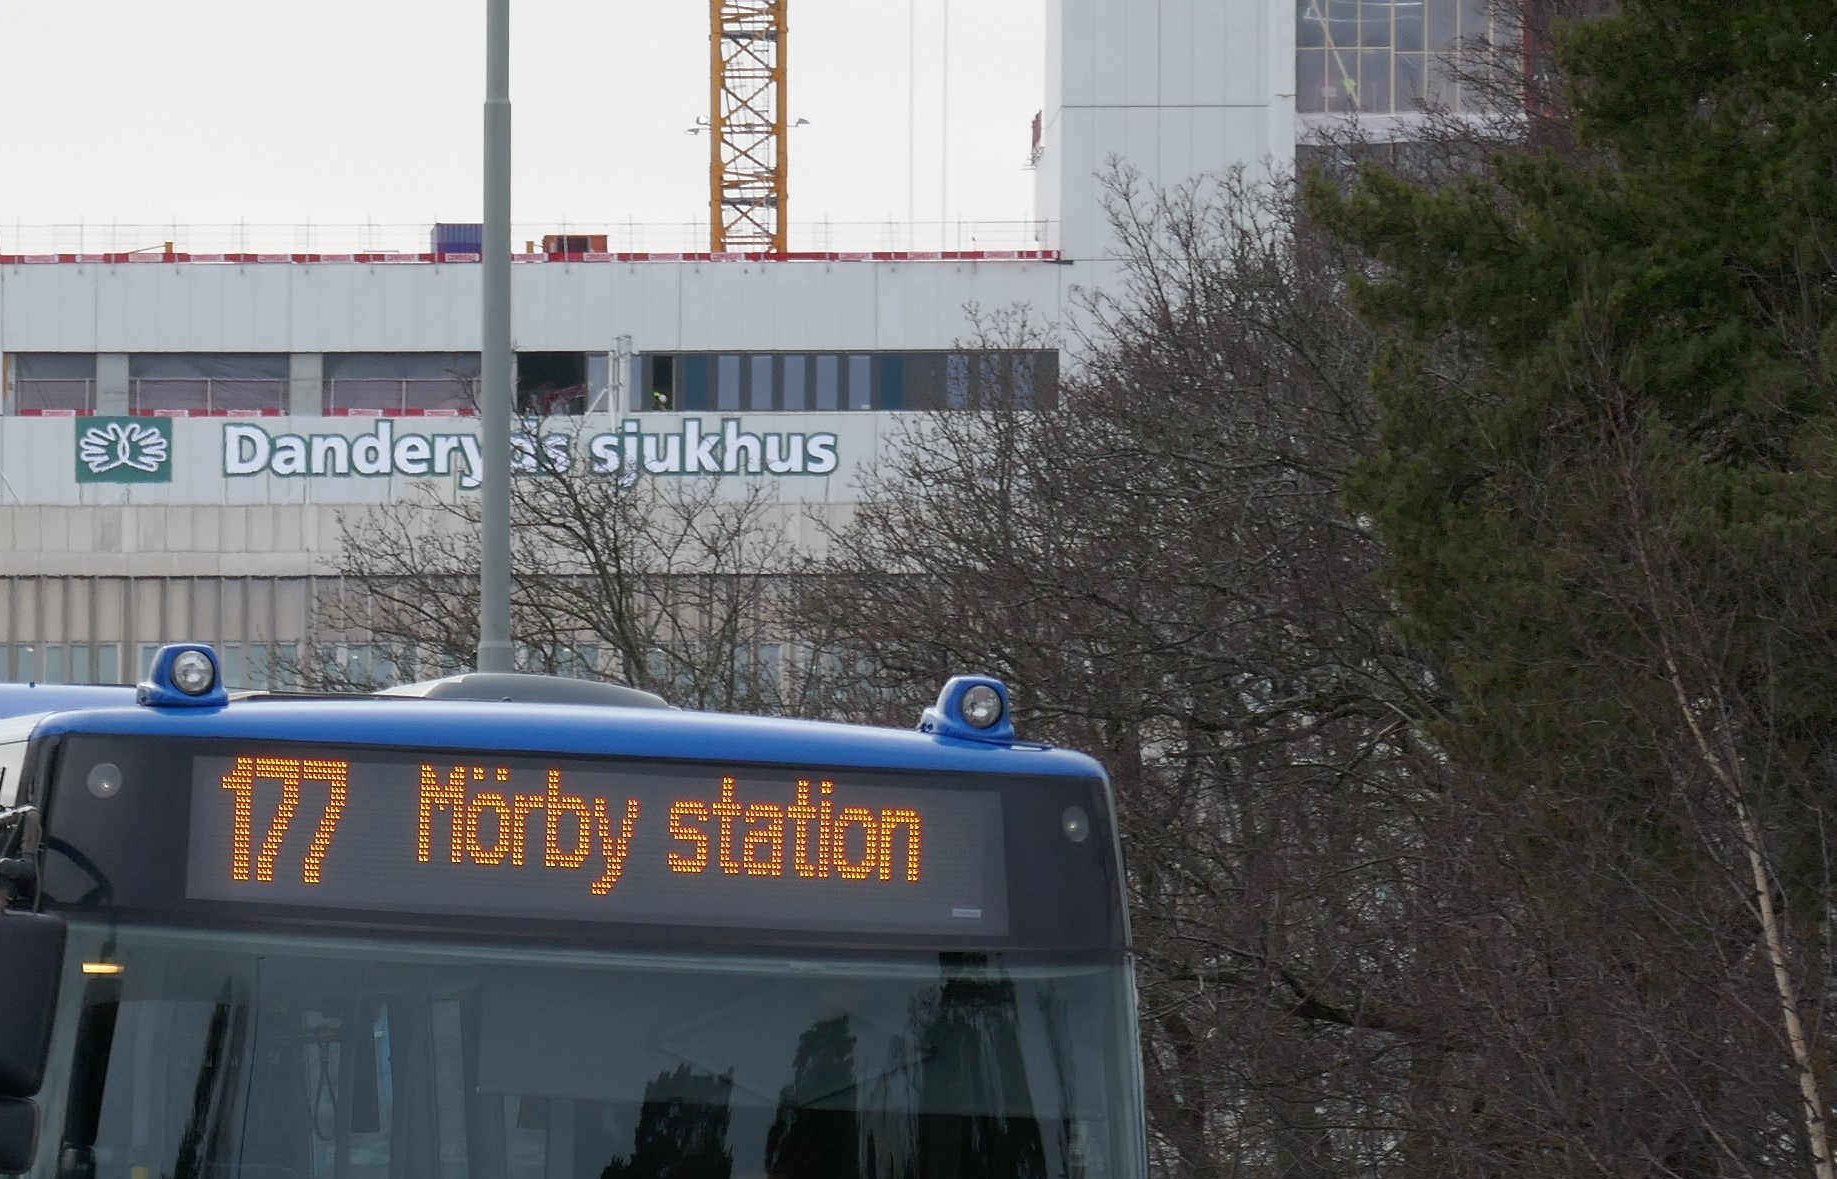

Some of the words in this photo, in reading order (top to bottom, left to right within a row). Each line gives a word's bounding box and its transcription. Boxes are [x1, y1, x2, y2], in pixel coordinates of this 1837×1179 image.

[589, 418, 838, 489] sjukhus
[221, 757, 348, 883] 177
[417, 764, 639, 896] Mörby
[667, 776, 920, 882] station
